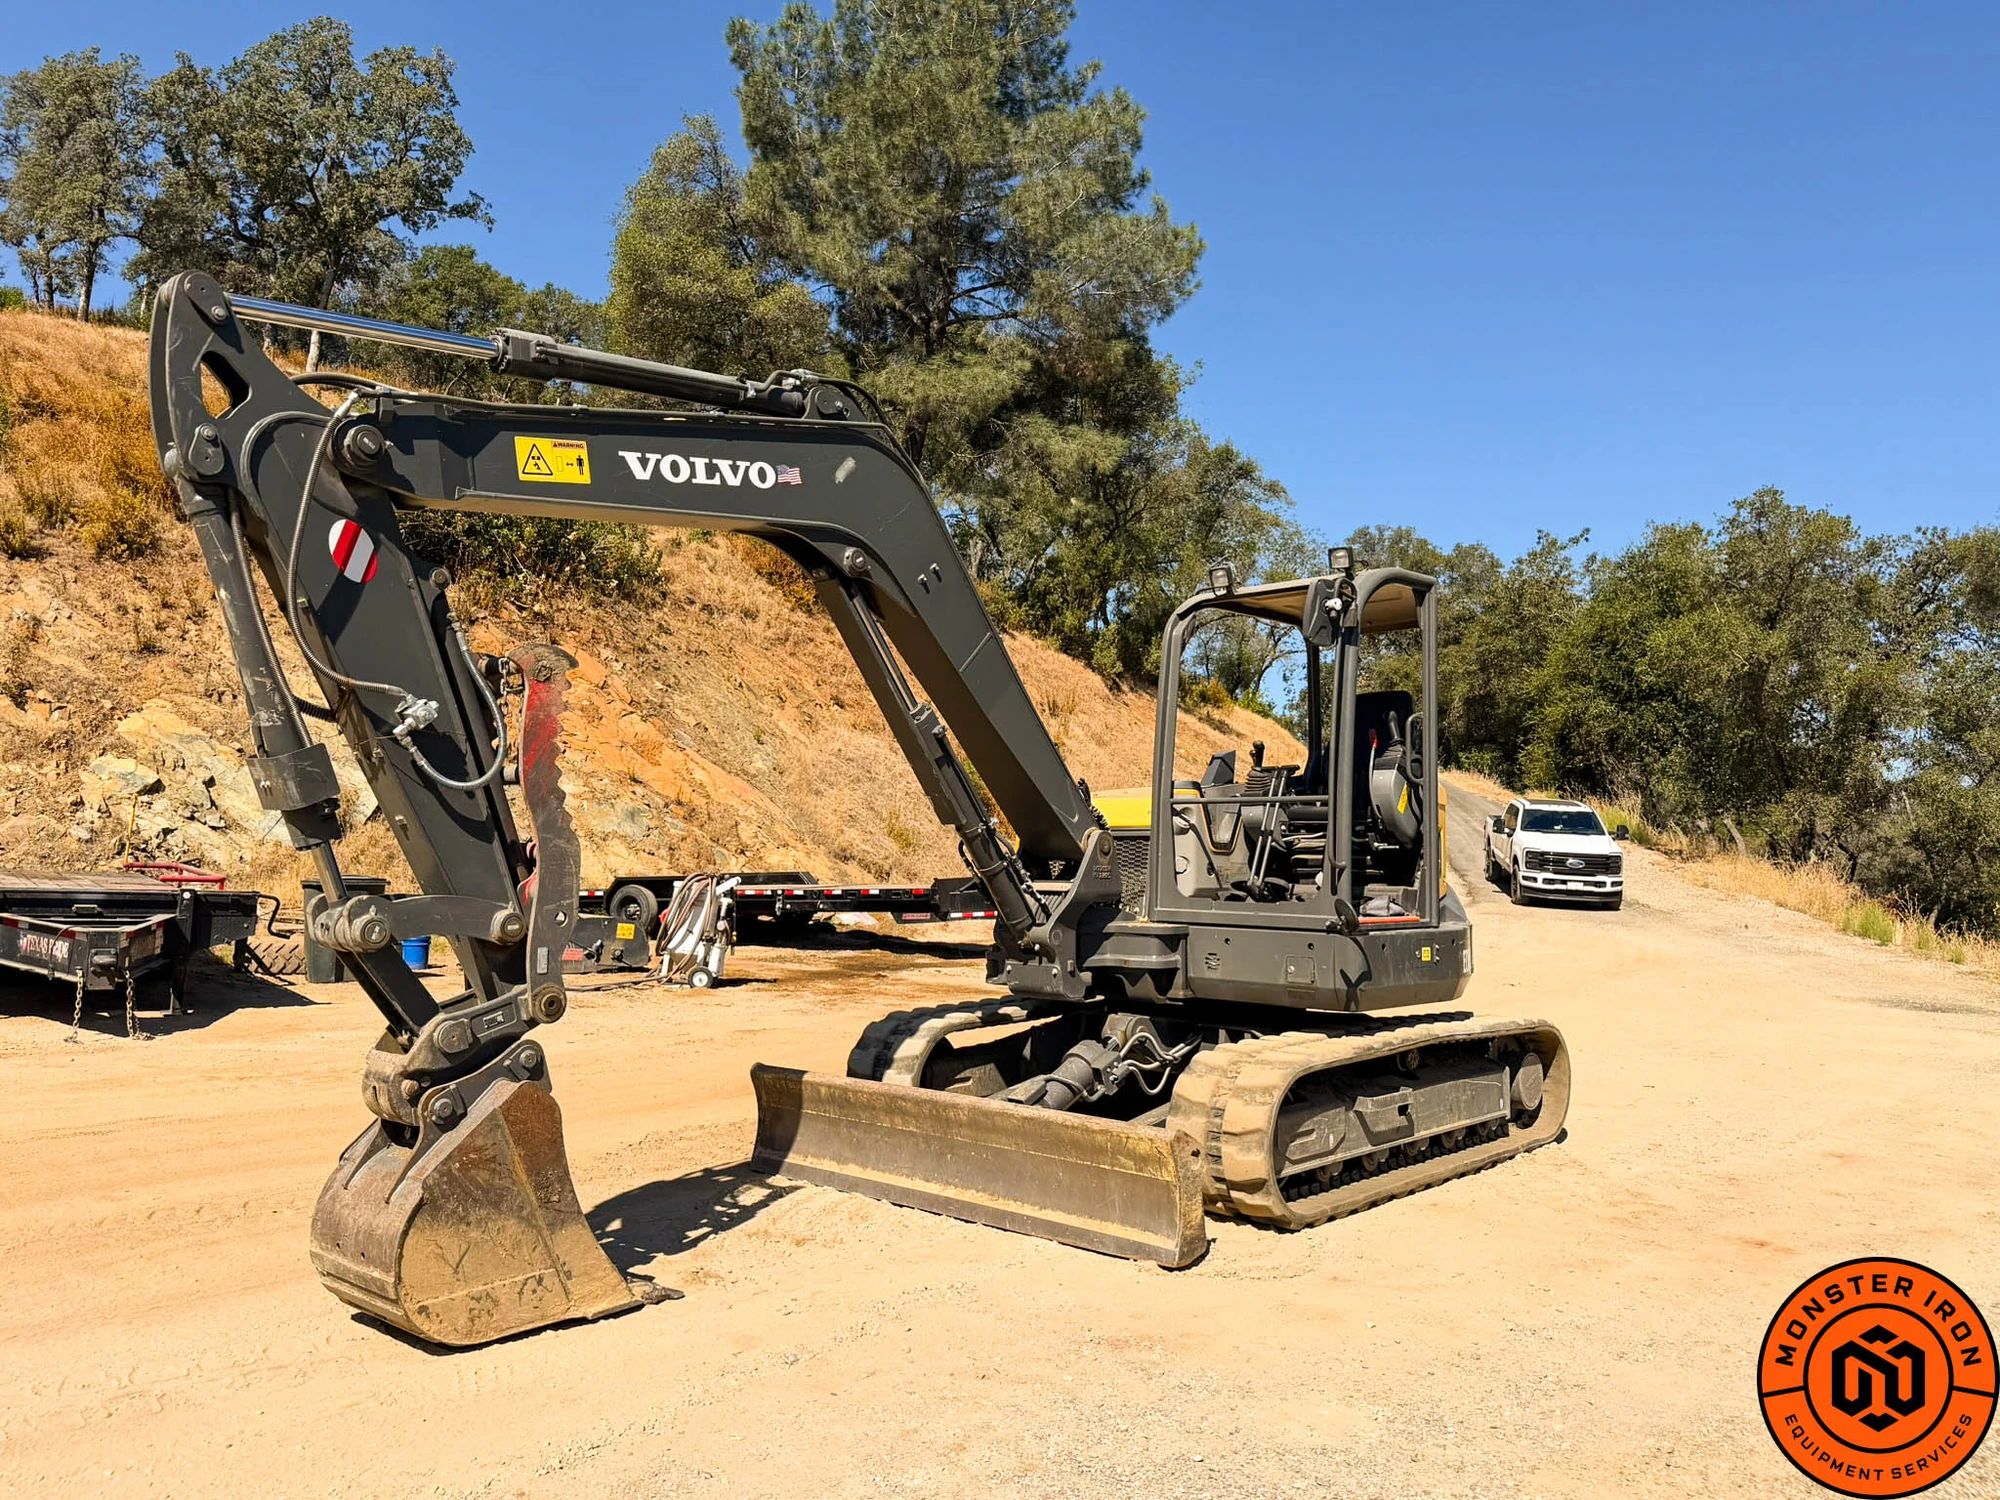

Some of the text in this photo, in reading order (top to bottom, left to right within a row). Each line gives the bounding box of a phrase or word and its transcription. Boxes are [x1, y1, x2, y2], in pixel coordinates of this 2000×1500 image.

[557, 441, 584, 449] WARNING
[618, 451, 777, 490] VOLVO
[27, 934, 48, 954] TEXAS
